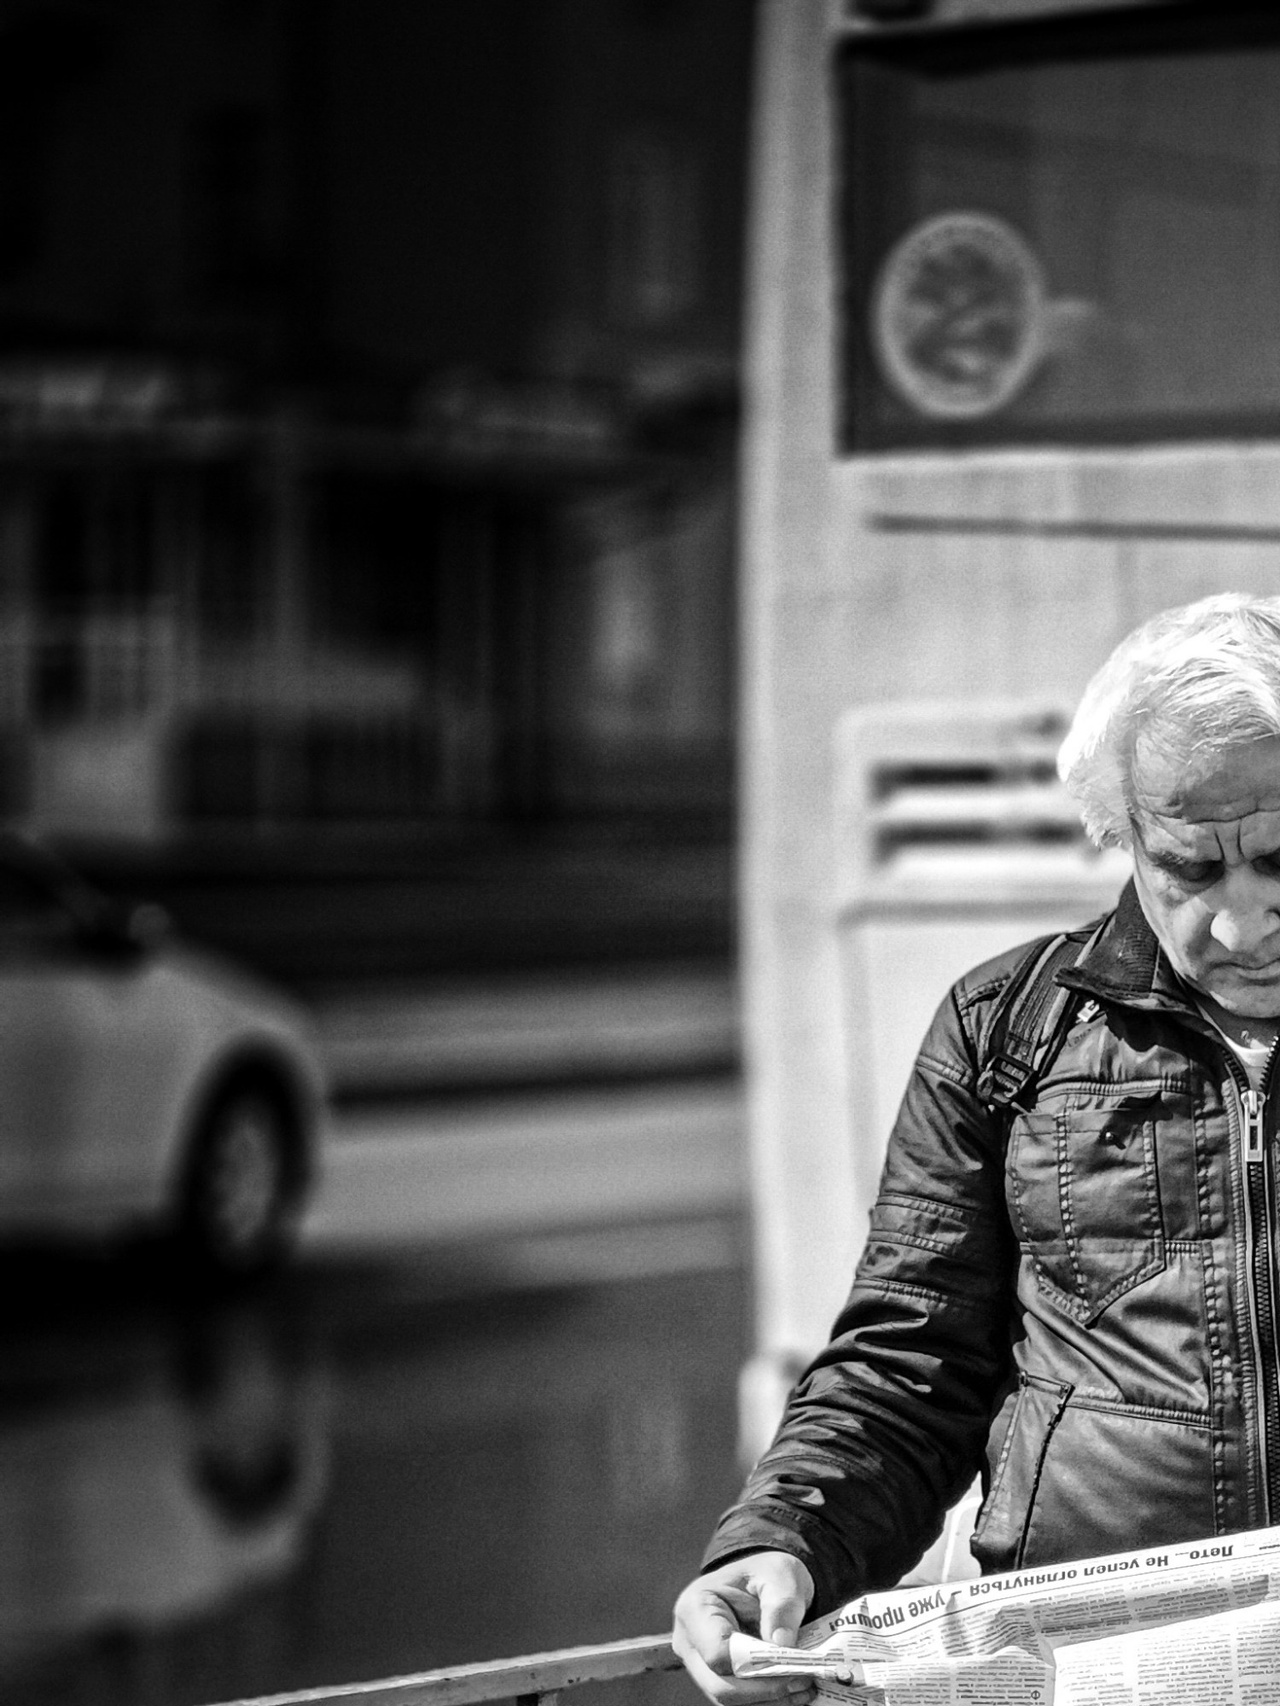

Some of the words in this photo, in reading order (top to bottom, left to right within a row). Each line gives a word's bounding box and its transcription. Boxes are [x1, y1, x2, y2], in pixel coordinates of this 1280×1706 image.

[1084, 1558, 1139, 1576] успел
[1146, 1555, 1168, 1567] Не
[970, 1569, 1077, 1597] оглянуться
[829, 1605, 905, 1631] прошло!
[908, 1590, 945, 1620] уже
